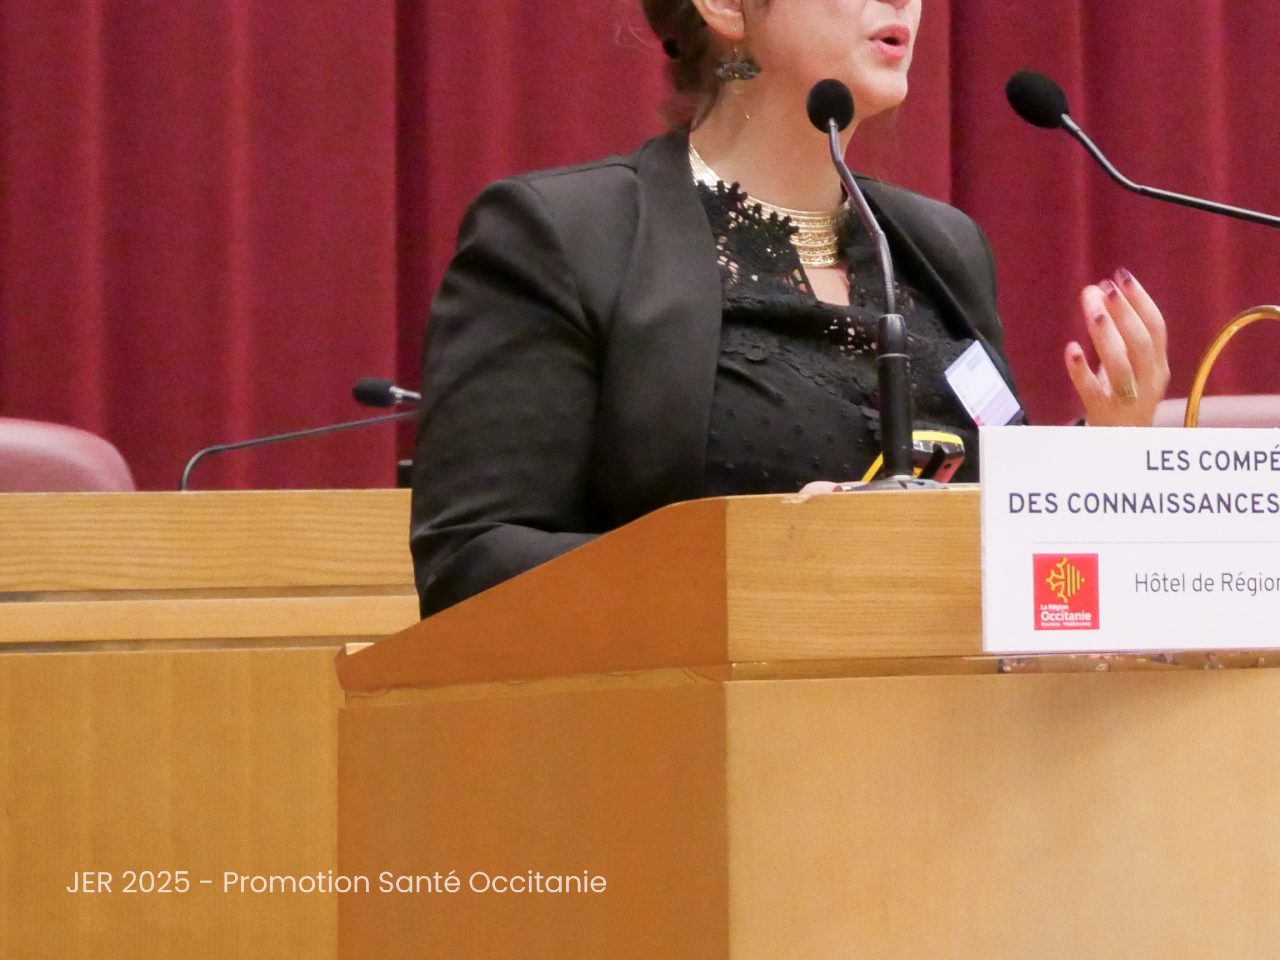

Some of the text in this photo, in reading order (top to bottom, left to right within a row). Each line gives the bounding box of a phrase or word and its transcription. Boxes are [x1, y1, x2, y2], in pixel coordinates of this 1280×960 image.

[1146, 449, 1191, 472] LES
[1009, 492, 1059, 514] DES
[1067, 492, 1280, 514] CONNAISSANCES
[1135, 572, 1185, 593] Hôtel
[1192, 573, 1215, 592] de
[1040, 610, 1092, 621] Occitanie
